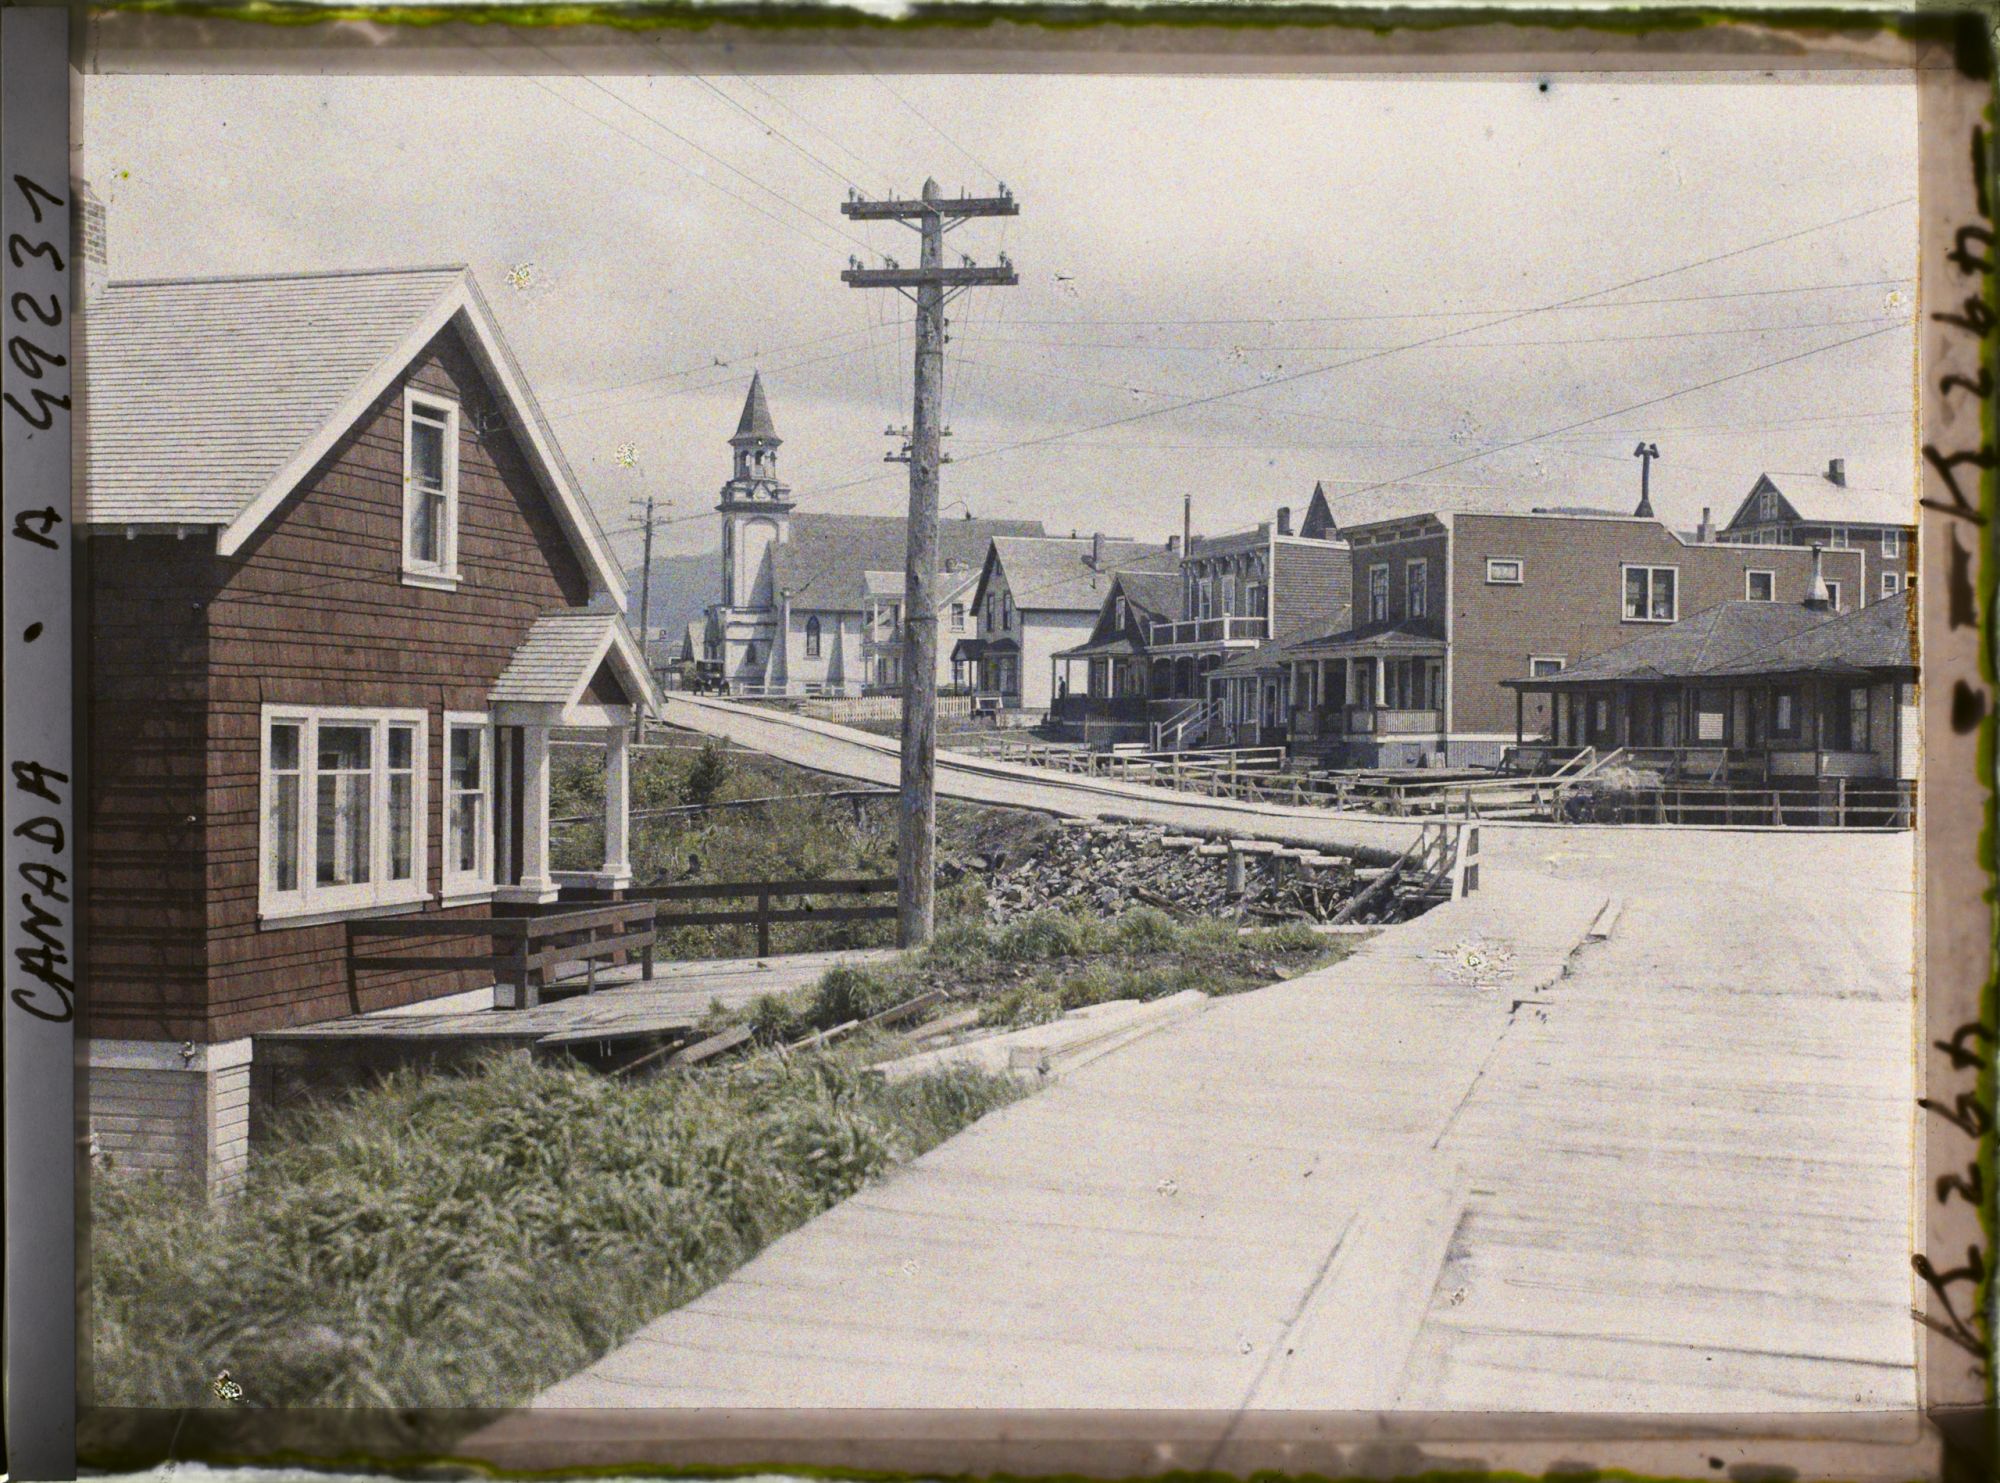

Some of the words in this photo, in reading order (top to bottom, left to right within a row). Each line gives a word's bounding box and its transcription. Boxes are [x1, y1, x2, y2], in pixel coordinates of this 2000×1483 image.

[3, 174, 71, 431] 49231
[12, 505, 63, 551] A
[11, 760, 75, 1023] CANADA
